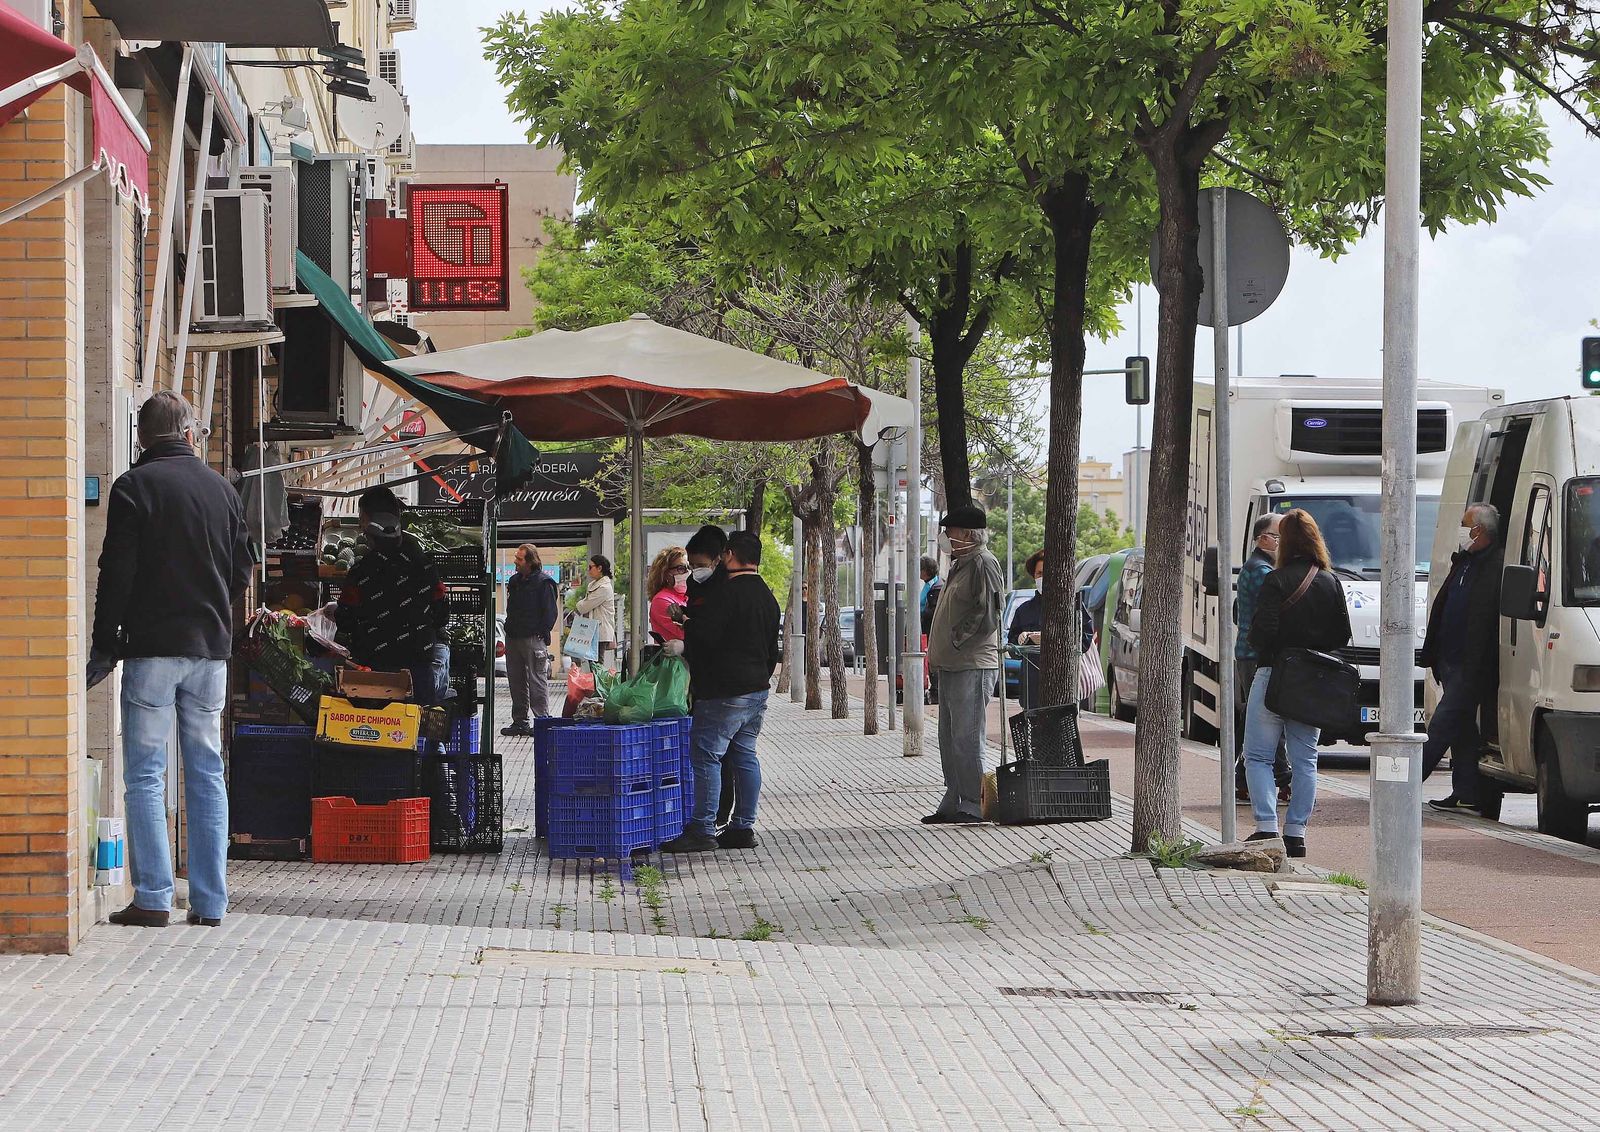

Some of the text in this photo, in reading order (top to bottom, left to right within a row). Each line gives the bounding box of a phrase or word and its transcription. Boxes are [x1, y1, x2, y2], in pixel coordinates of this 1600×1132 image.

[422, 281, 499, 301] 11:52
[330, 712, 401, 726] SABOR DE CHIPIONA
